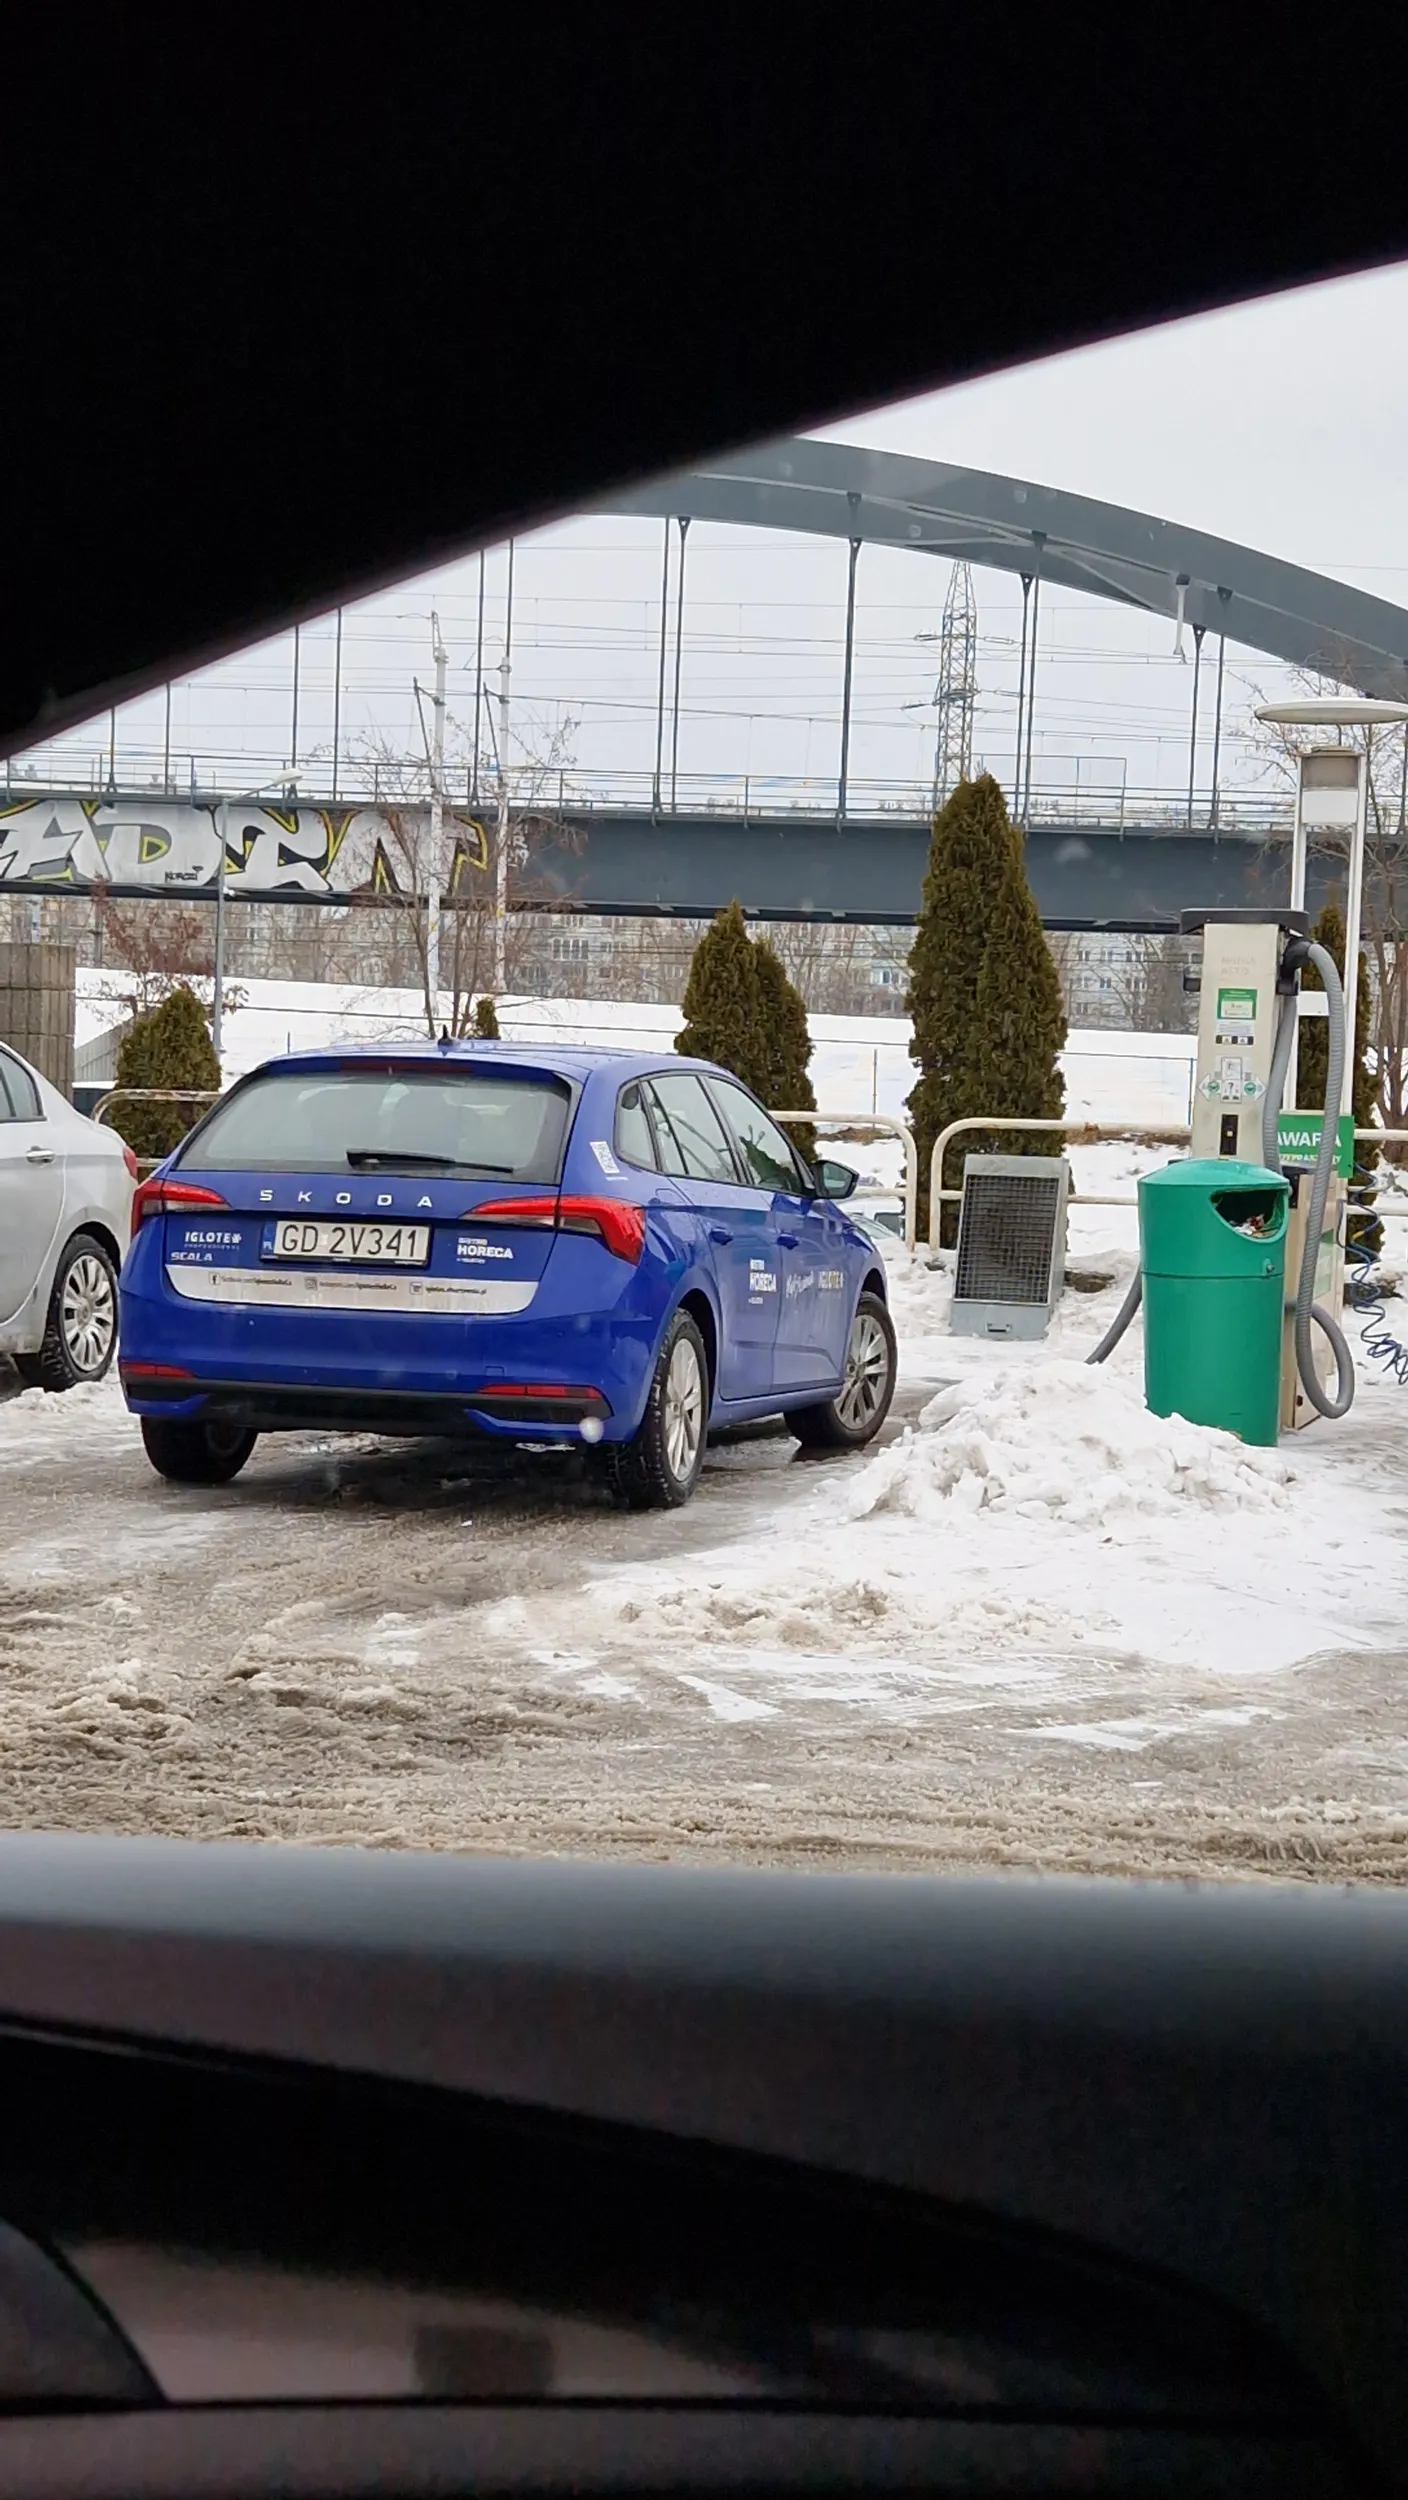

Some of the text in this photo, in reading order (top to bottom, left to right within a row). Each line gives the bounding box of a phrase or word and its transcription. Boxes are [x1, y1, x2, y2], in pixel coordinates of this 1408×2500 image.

[259, 1189, 433, 1207] SKODA
[281, 1224, 417, 1257] GD 2V341
[170, 1251, 213, 1262] SCALA
[457, 1244, 514, 1259] HORECA
